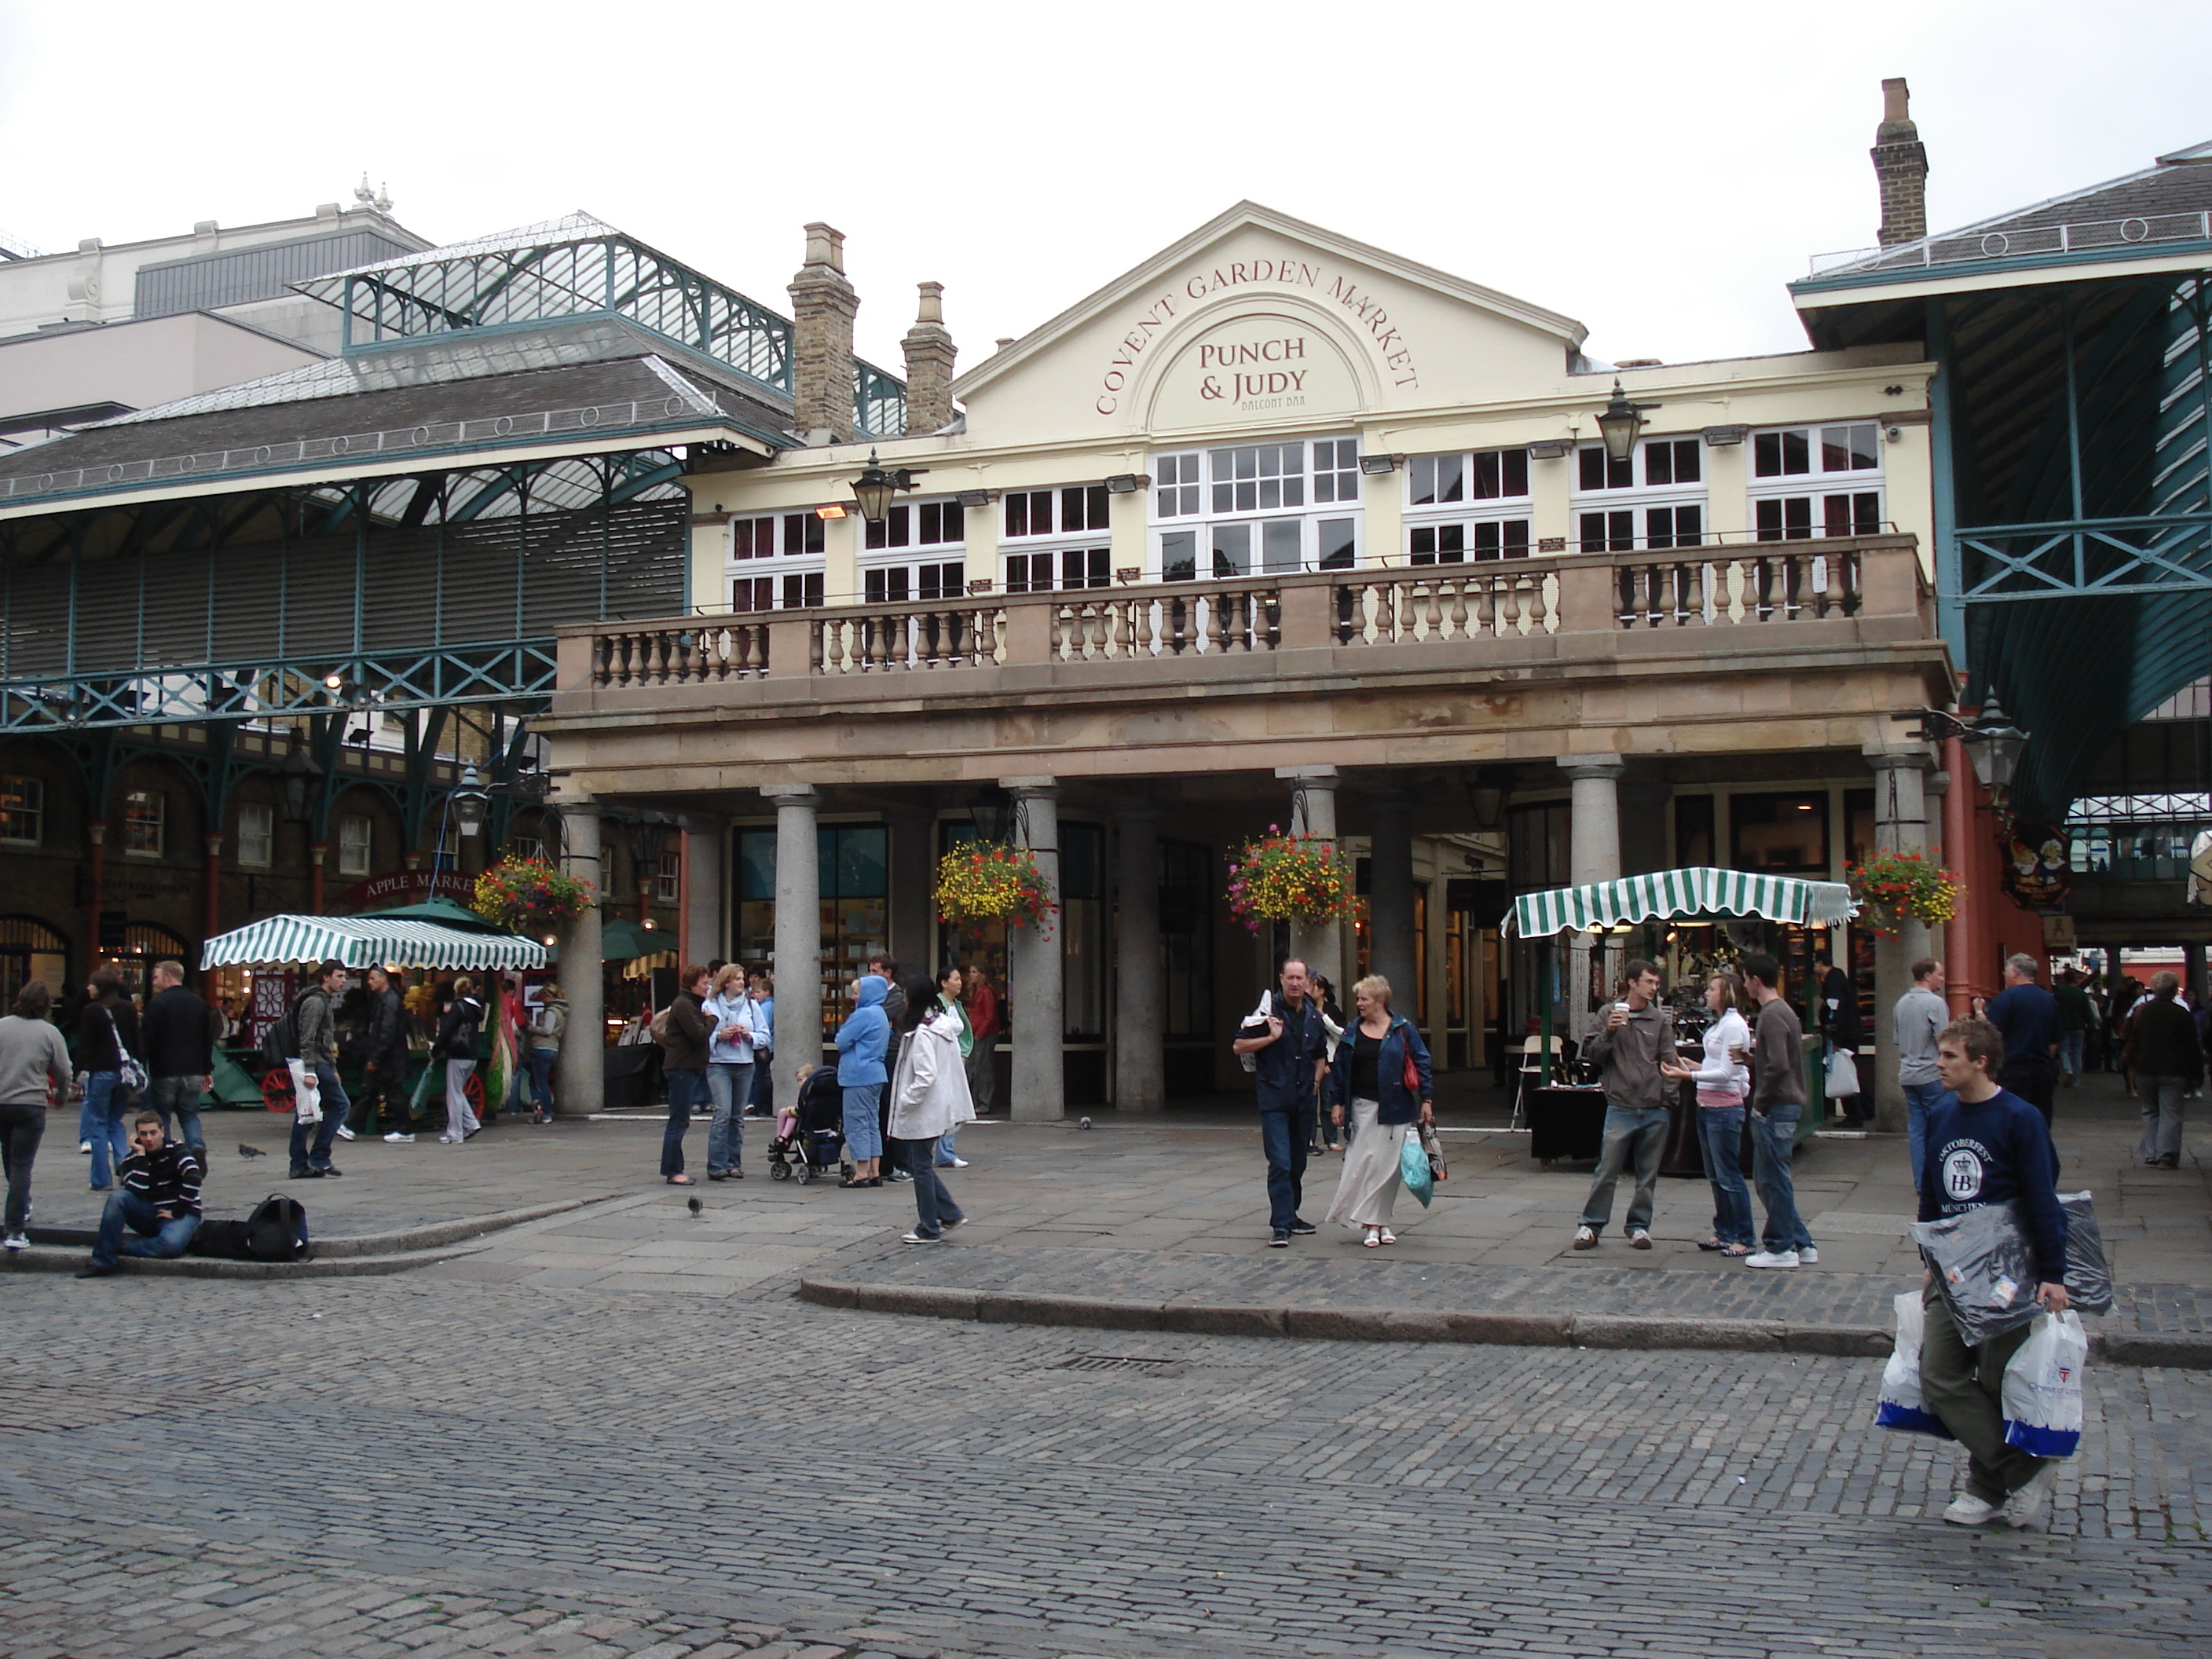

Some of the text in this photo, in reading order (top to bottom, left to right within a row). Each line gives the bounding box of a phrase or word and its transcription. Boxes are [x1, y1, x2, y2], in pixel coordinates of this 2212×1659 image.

[1097, 259, 1419, 415] COVENT GARDEN MARKET
[1199, 337, 1306, 369] PUNCH
[1200, 369, 1309, 406] & JUDY
[1241, 395, 1306, 412] BALCONY BAR
[366, 873, 472, 898] APPLE MARKE
[1939, 1137, 1994, 1163] OKTOBERFEST
[1952, 1174, 1972, 1192] HB
